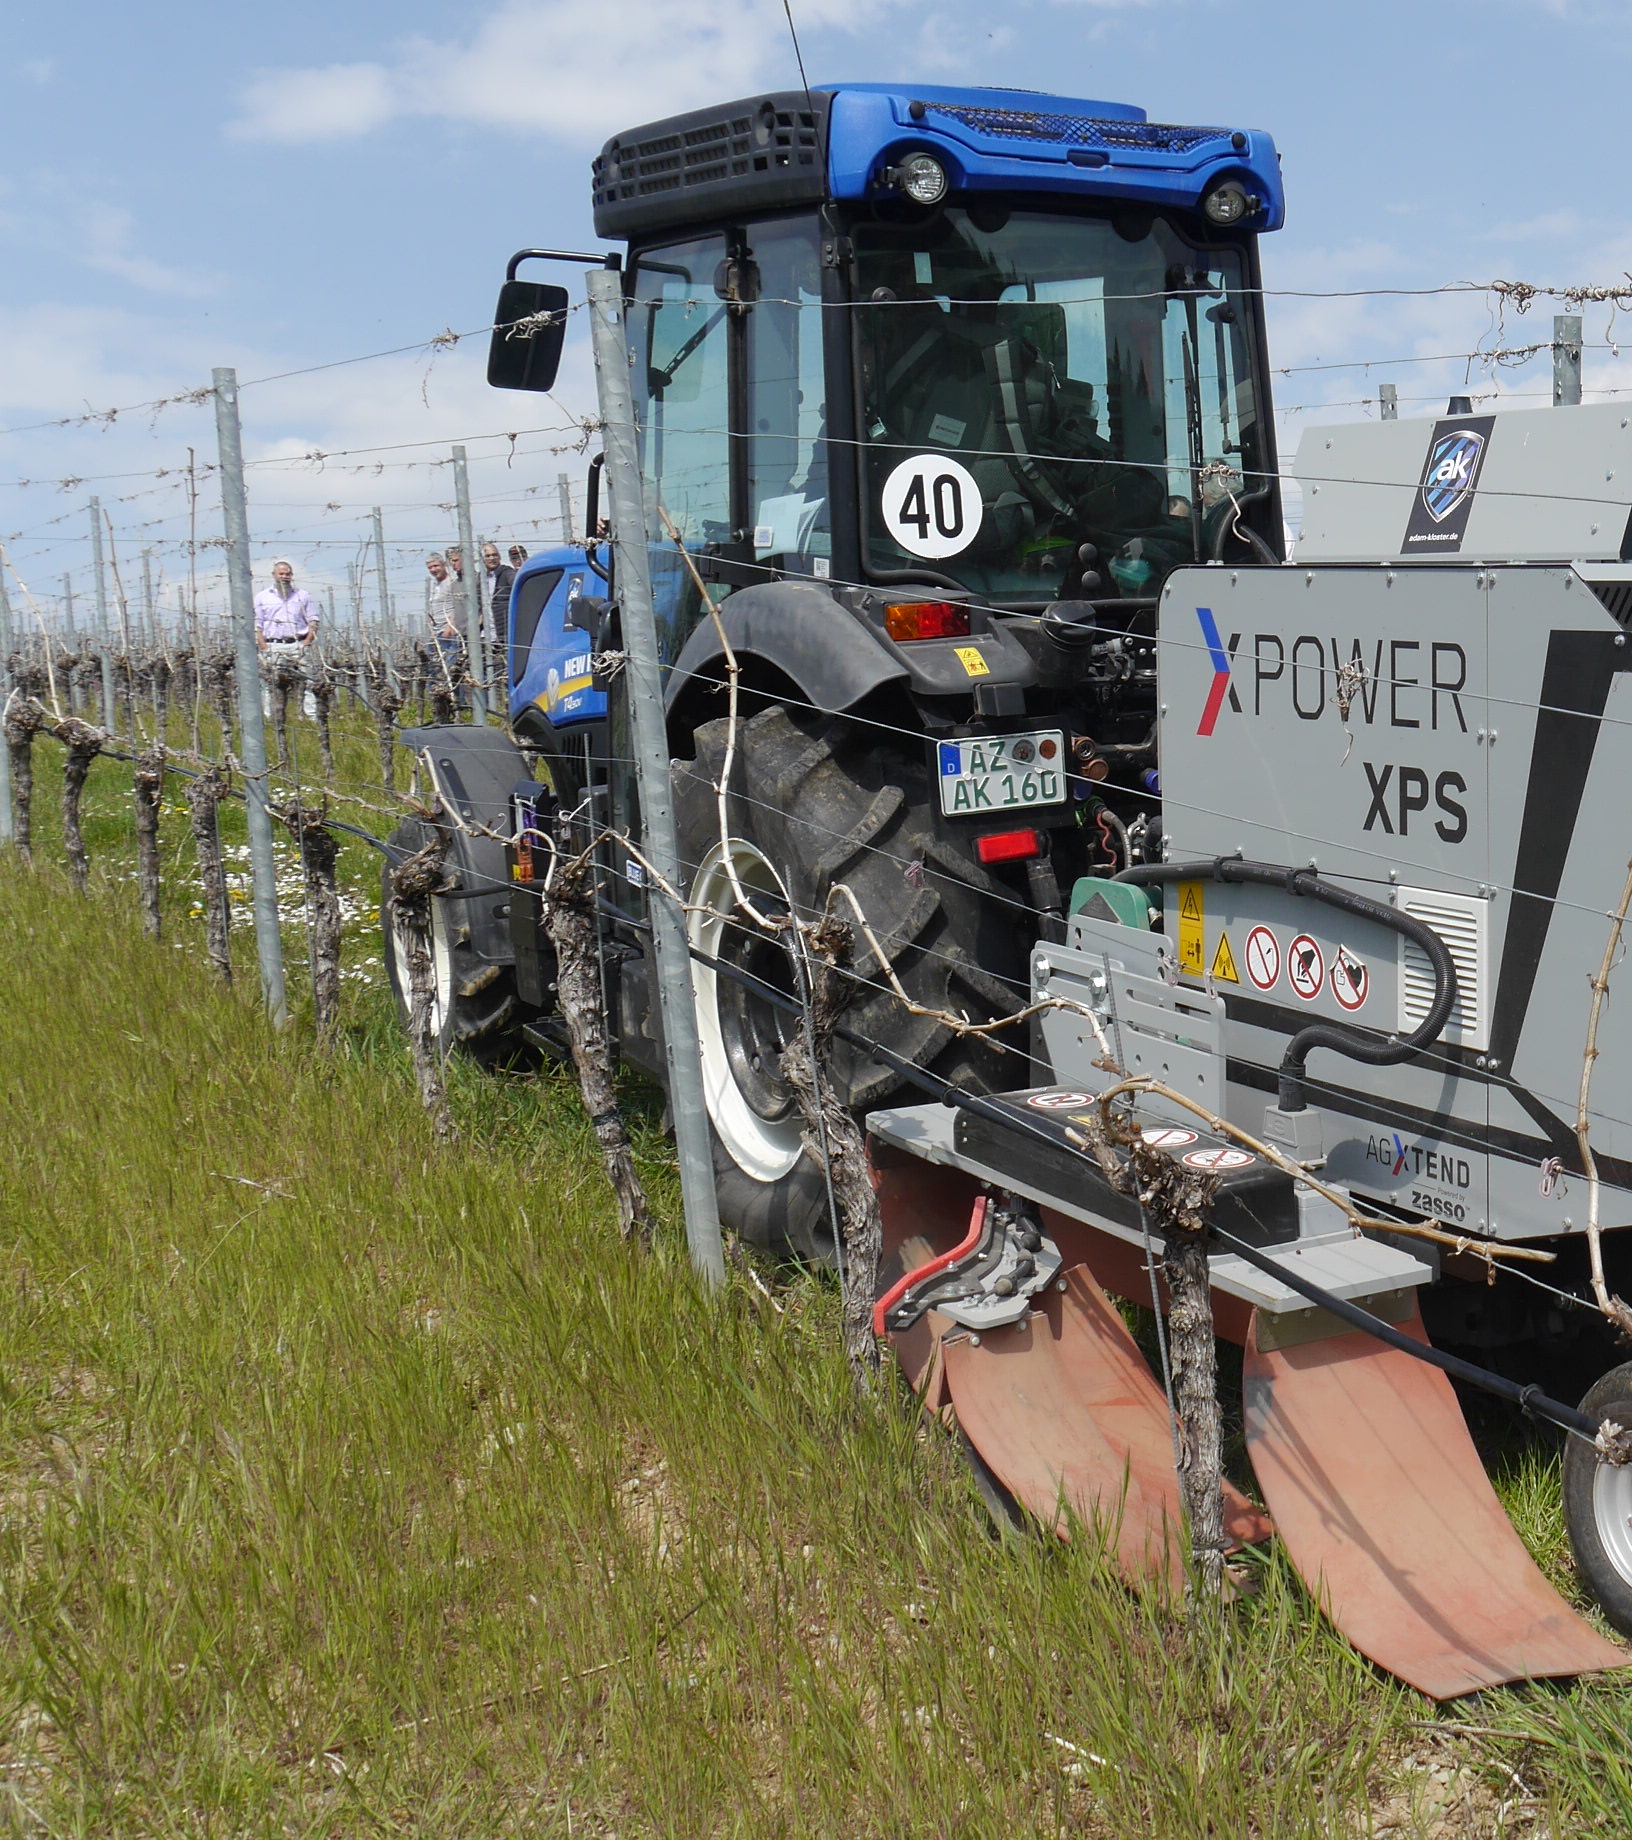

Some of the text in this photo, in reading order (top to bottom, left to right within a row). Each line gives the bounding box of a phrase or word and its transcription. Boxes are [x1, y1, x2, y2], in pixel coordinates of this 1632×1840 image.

[1436, 450, 1471, 481] ak
[899, 473, 964, 539] 40
[1408, 532, 1459, 542] adam-kloster.de
[564, 654, 586, 679] NEW
[1195, 607, 1468, 737] XPOWER
[947, 762, 956, 774] D
[969, 741, 1008, 775] AZ
[953, 769, 1058, 811] AK 160
[1362, 761, 1468, 844] XPS
[1366, 1132, 1471, 1189] AGXTEND
[1411, 1190, 1466, 1222] zasso
[1437, 1187, 1459, 1199] Powered
